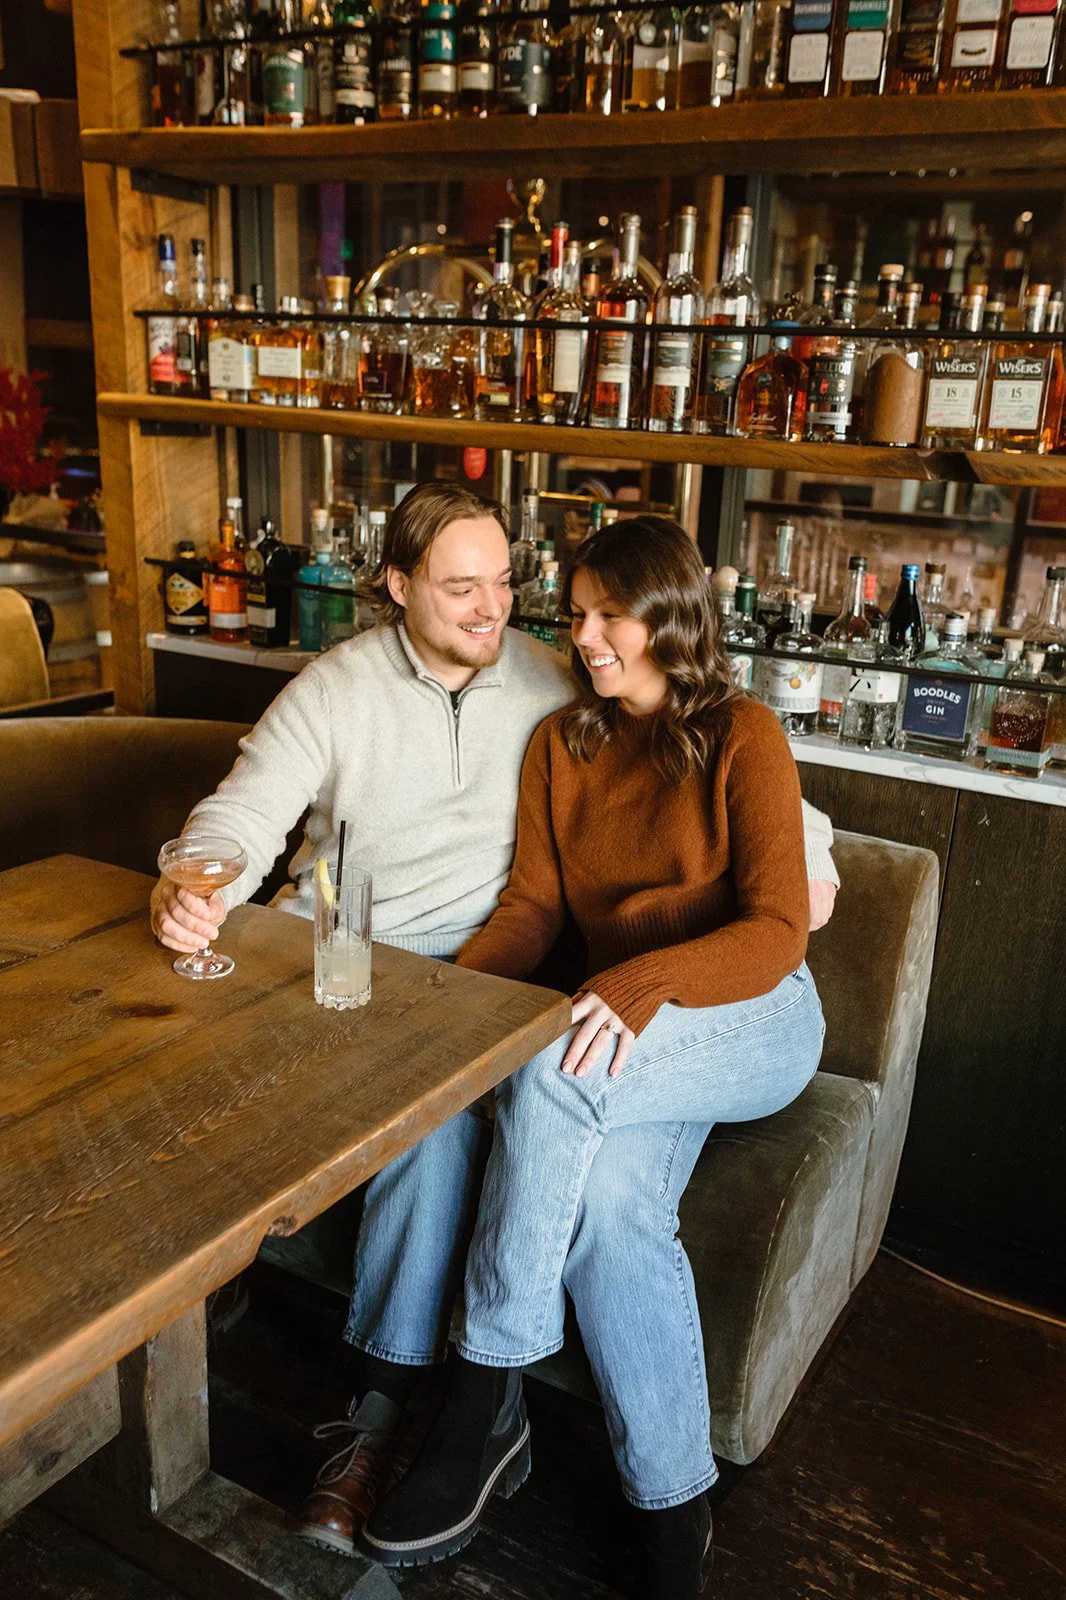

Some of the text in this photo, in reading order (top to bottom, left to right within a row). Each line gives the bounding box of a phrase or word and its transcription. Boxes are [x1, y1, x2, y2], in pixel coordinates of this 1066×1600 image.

[946, 387, 957, 398] 18
[1011, 387, 1022, 398] 15
[913, 686, 962, 705] BOODLES
[925, 704, 945, 716] GIN
